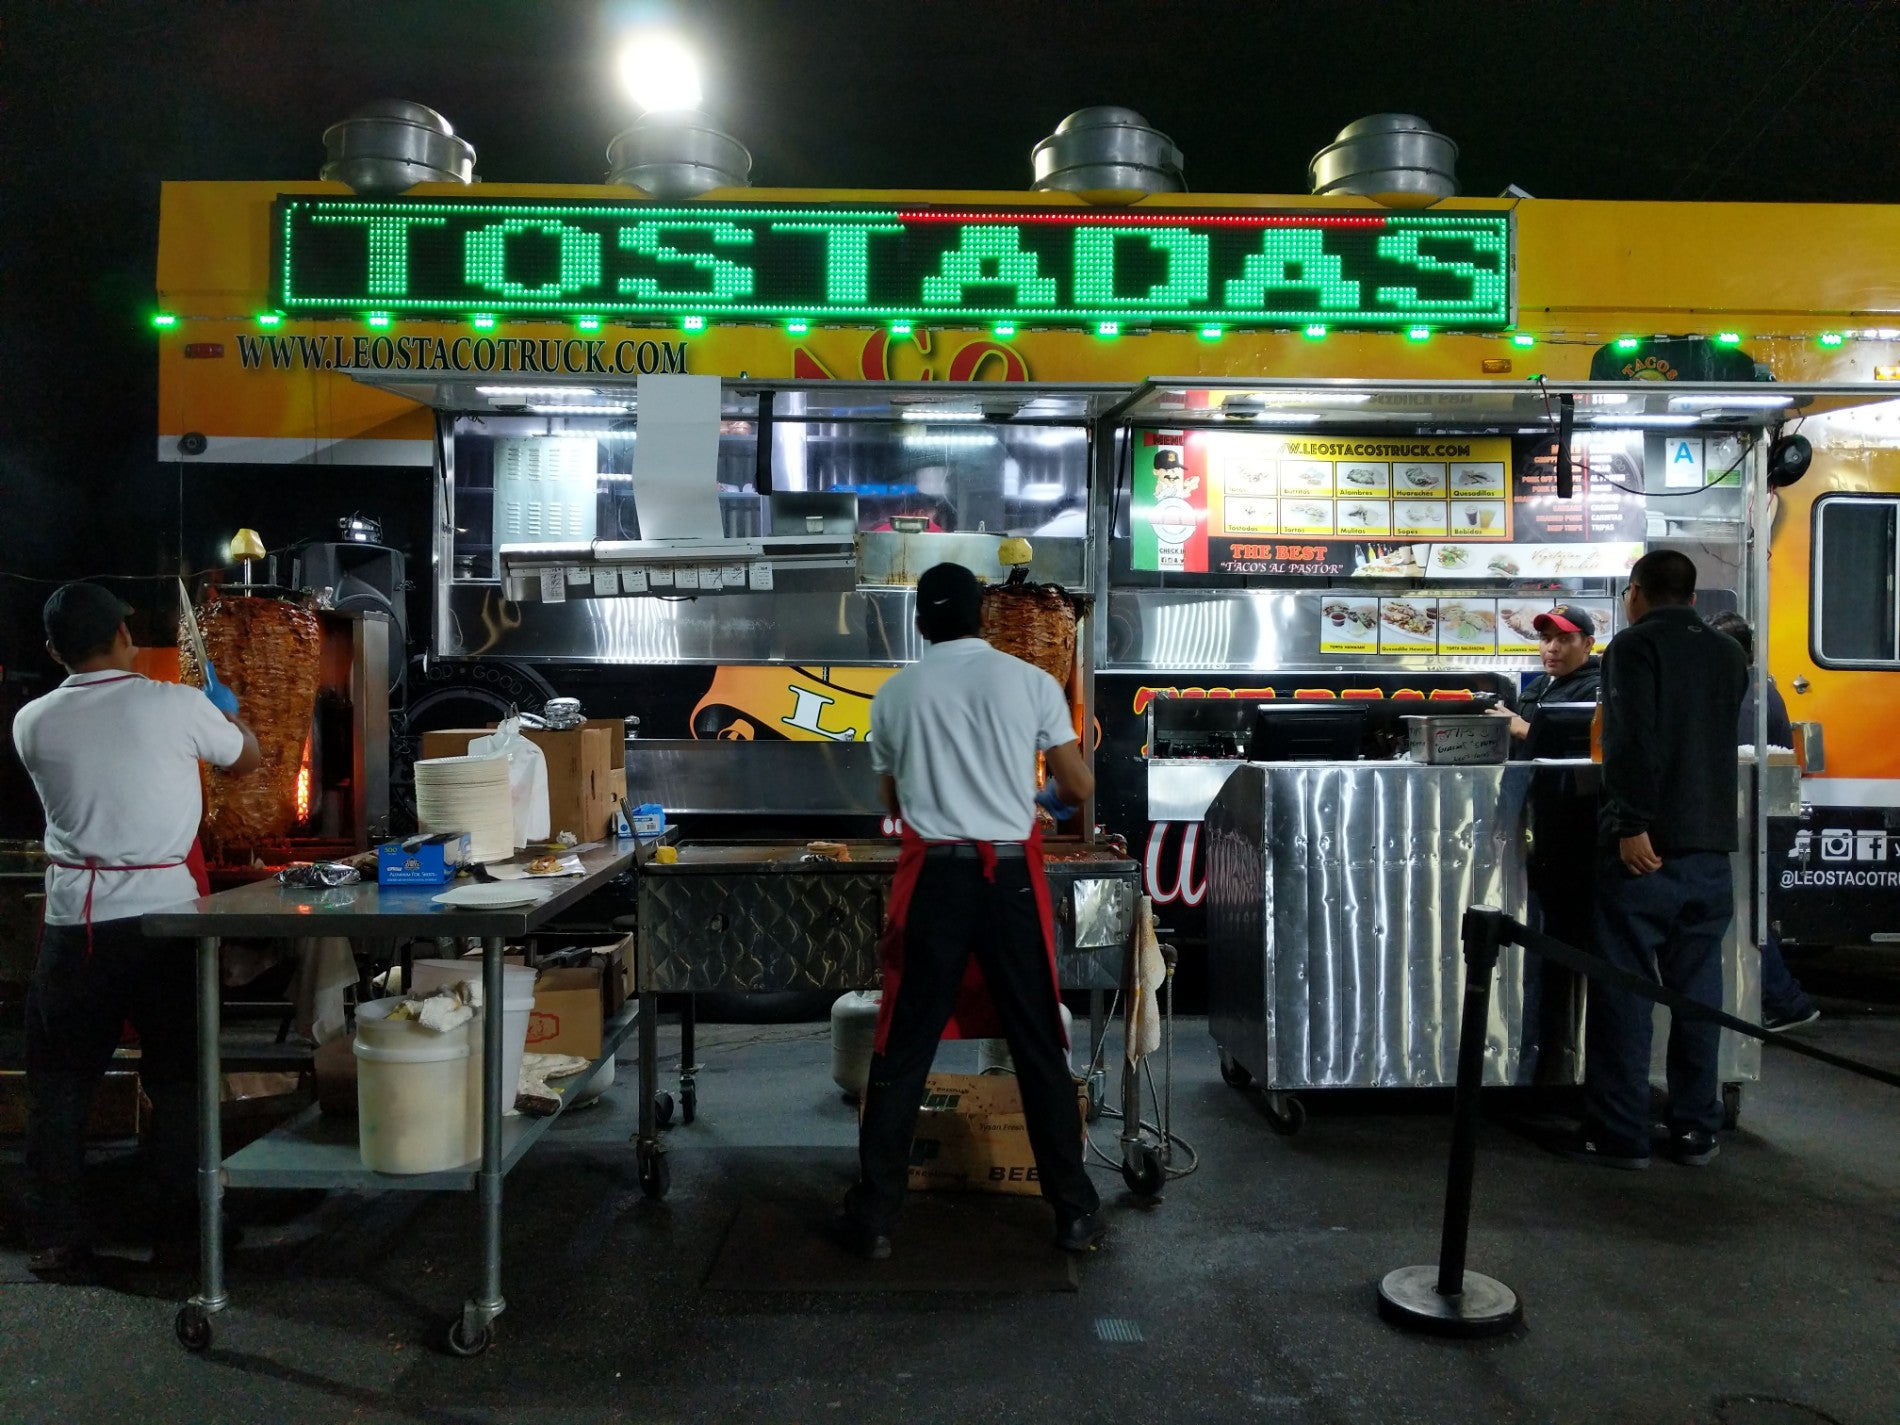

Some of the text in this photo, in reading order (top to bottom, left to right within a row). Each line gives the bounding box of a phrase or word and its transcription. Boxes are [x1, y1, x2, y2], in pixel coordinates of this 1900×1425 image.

[311, 214, 1501, 309] TOSTADAS
[236, 334, 689, 375] WWW.LEOSTACOTRUCK.COM
[1622, 356, 1679, 381] TACOS
[1674, 441, 1694, 464] A
[1228, 524, 1258, 532] Tostadas
[1230, 543, 1328, 561] THE BEST
[1269, 562, 1286, 573] AL
[1780, 870, 1900, 889] @LEOSTACOTR
